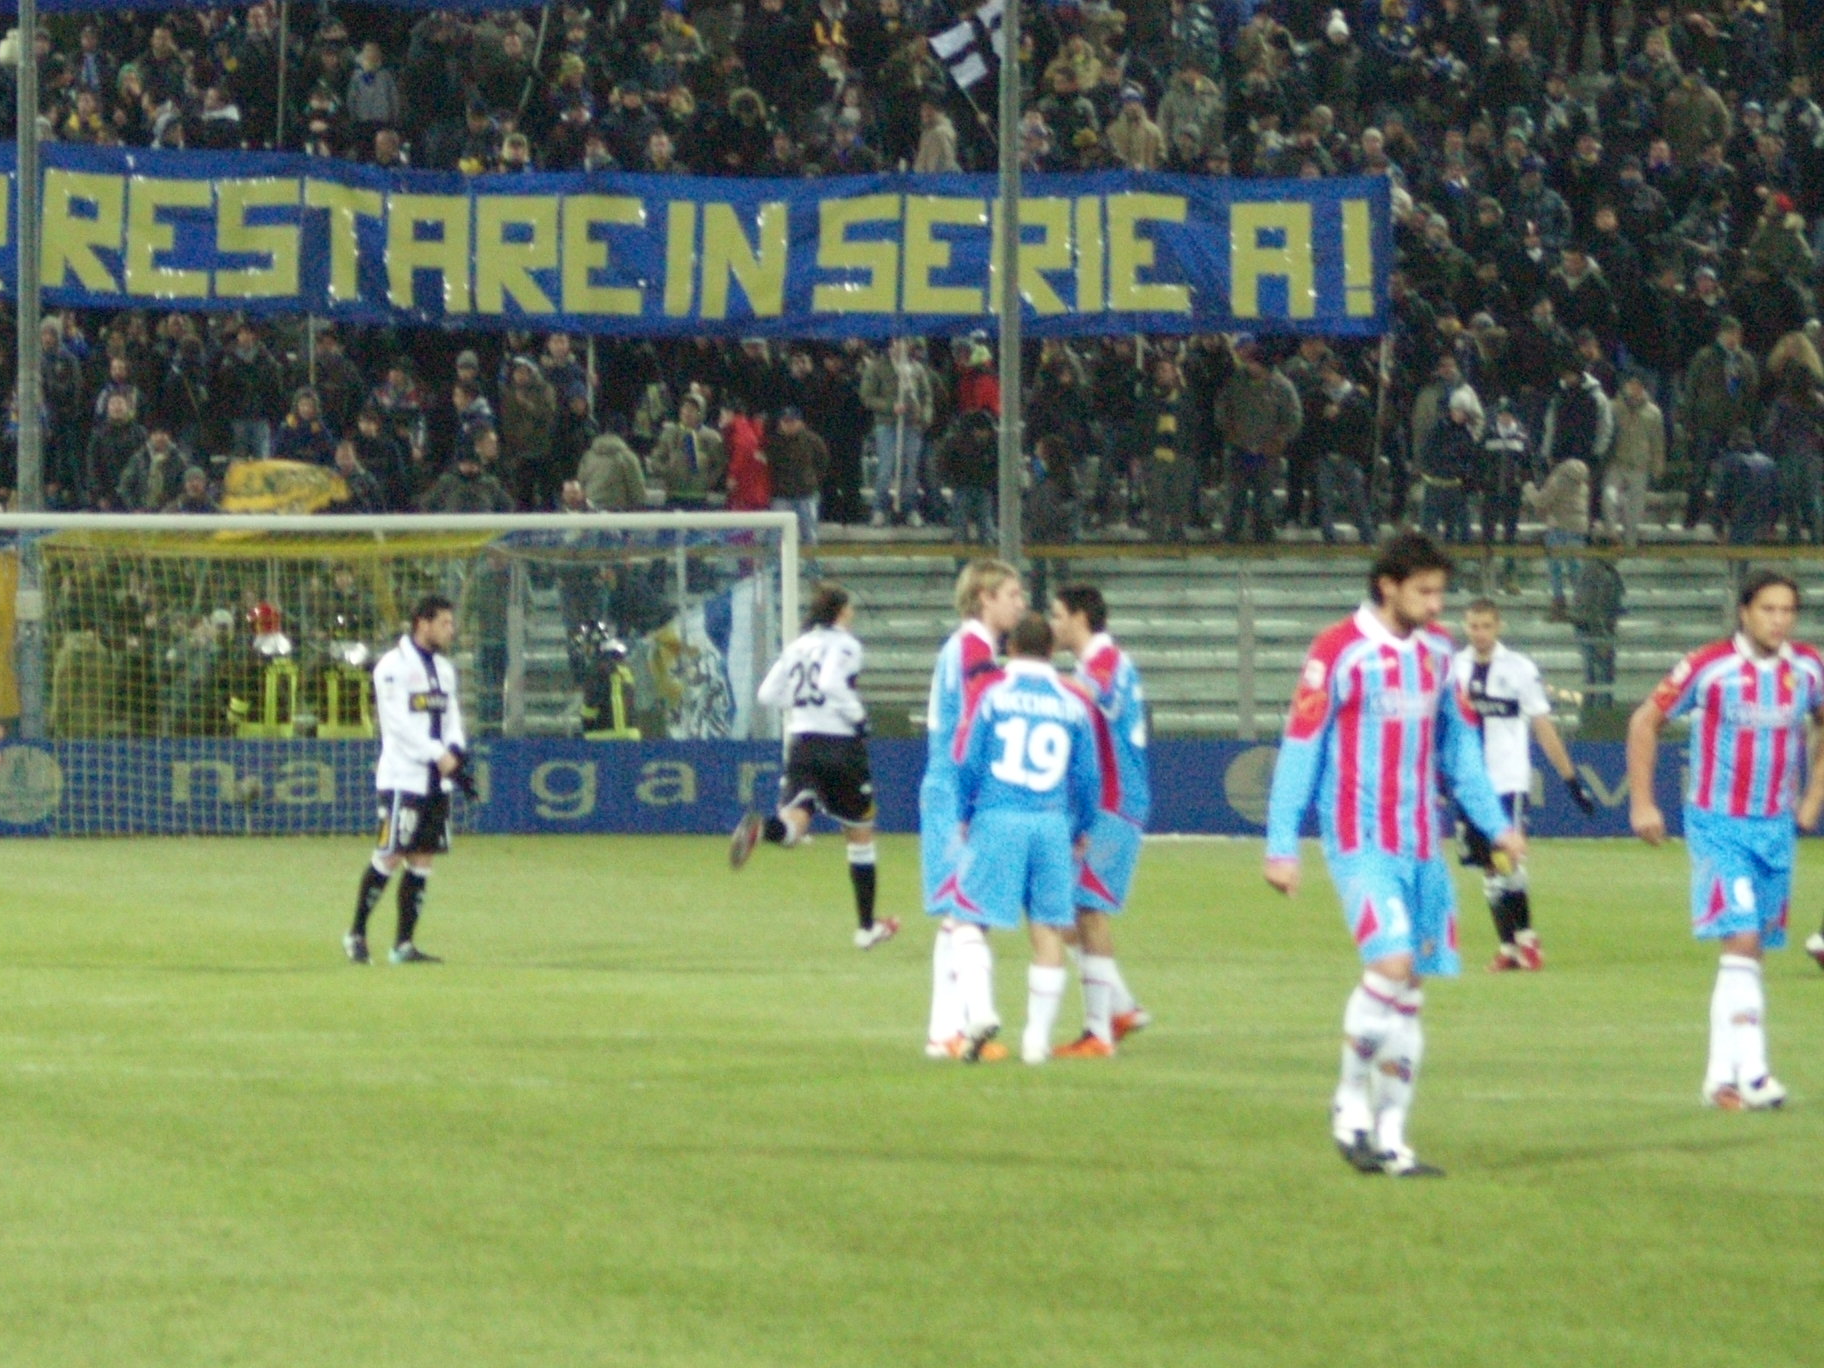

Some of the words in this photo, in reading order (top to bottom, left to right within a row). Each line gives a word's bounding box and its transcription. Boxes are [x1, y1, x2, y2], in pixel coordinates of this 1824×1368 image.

[39, 167, 644, 315] RESTARE
[663, 200, 789, 319] IN
[813, 192, 1191, 315] SERIE
[991, 716, 1073, 792] 19
